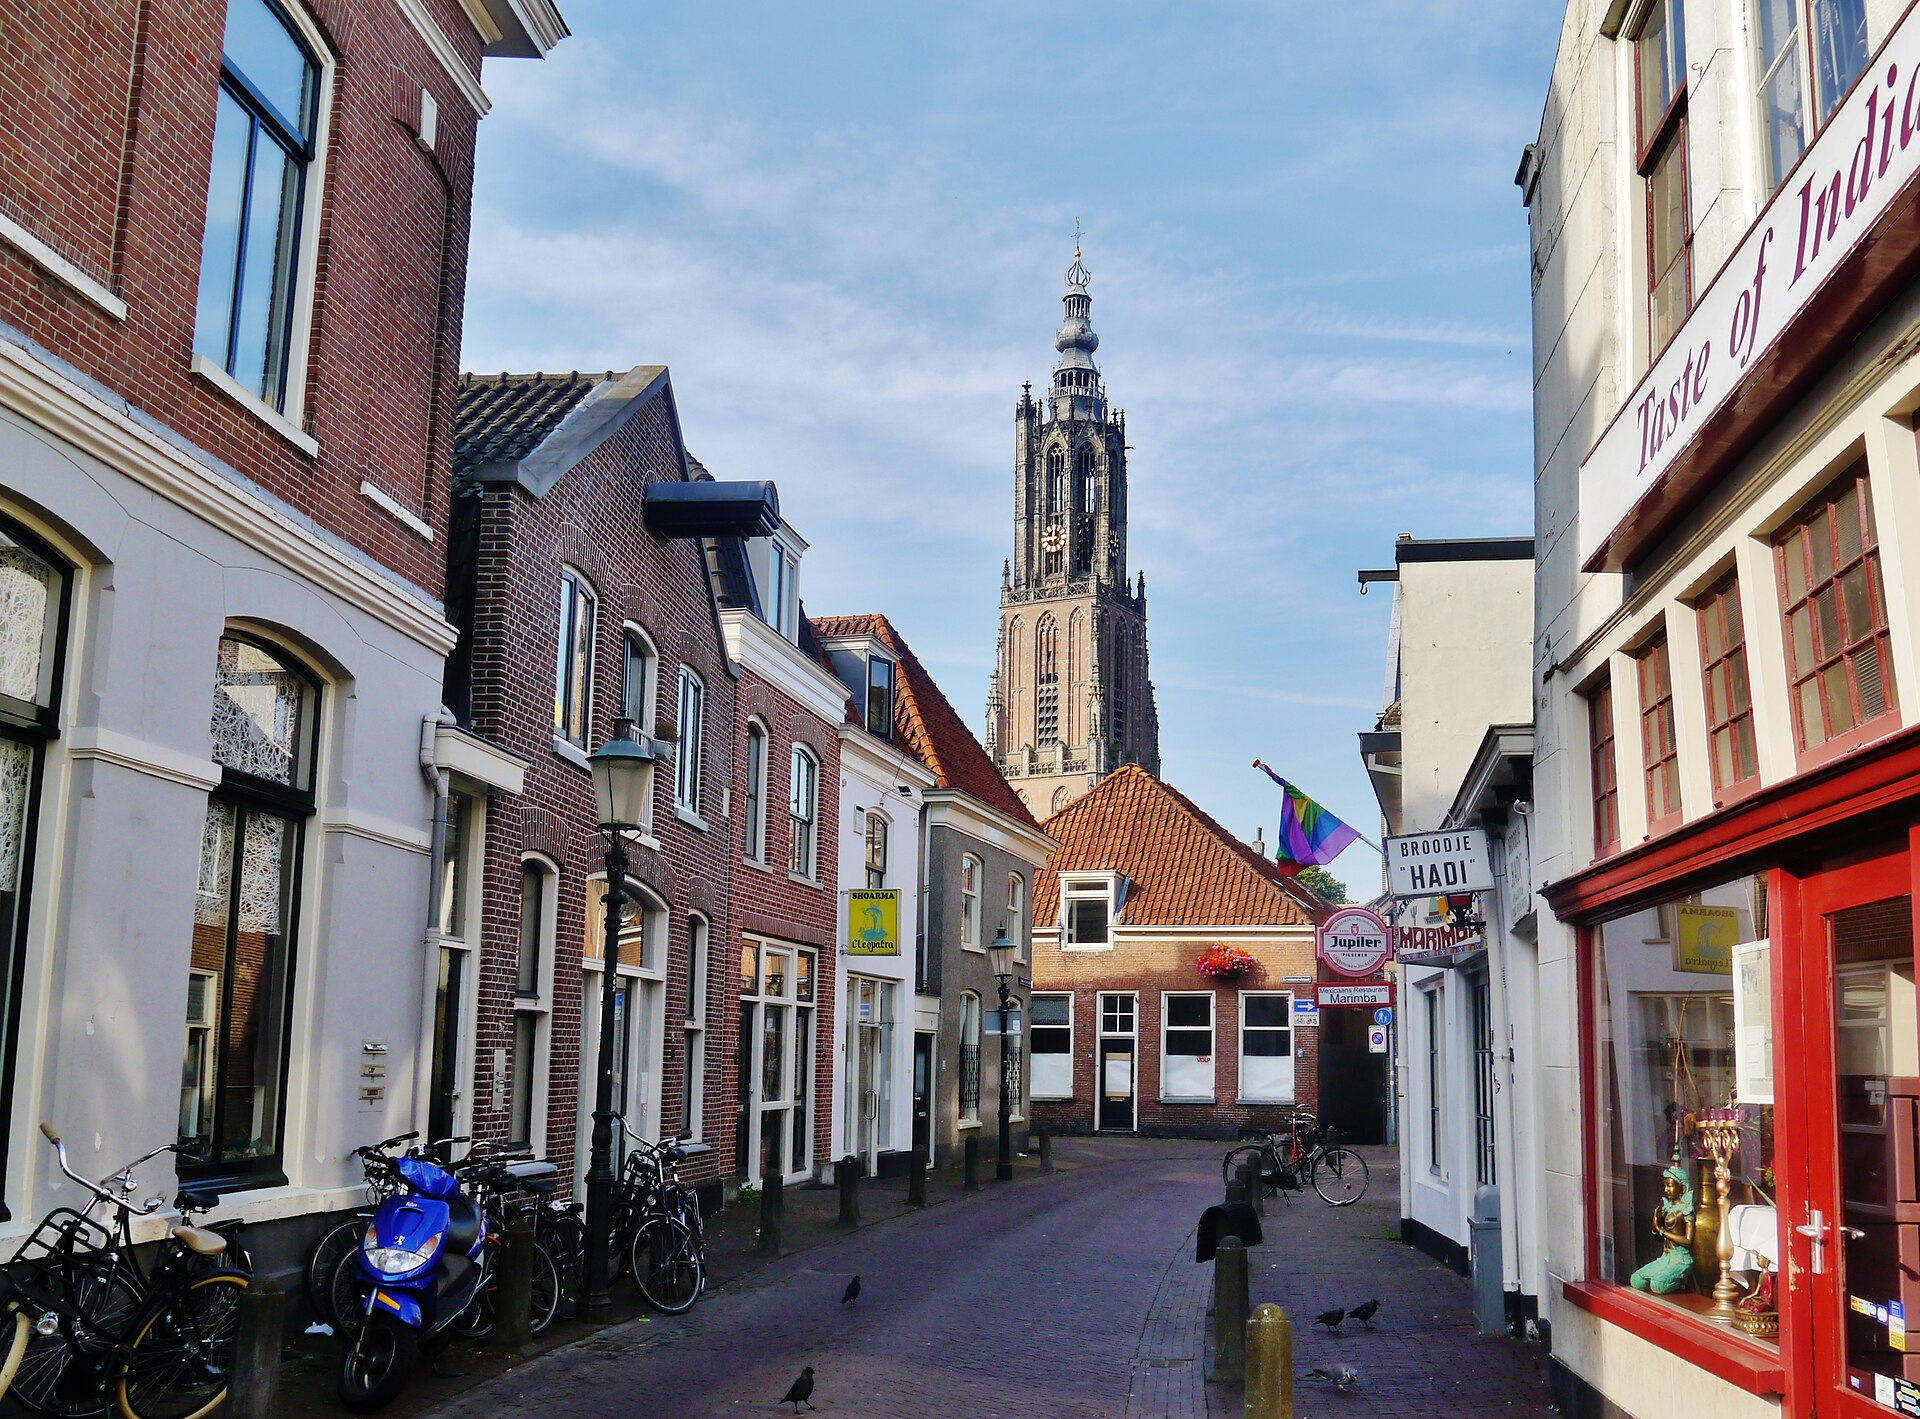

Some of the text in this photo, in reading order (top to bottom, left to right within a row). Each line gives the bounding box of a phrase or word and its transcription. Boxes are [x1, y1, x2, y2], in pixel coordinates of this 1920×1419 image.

[1637, 340, 1711, 477] Taste
[1729, 226, 1774, 369] of
[1400, 835, 1472, 857] BROODJE
[852, 892, 895, 900] SHOARMA
[852, 939, 894, 953] Cleopatra
[1330, 935, 1381, 950] Jupiler
[1330, 993, 1377, 1004] Marimba
